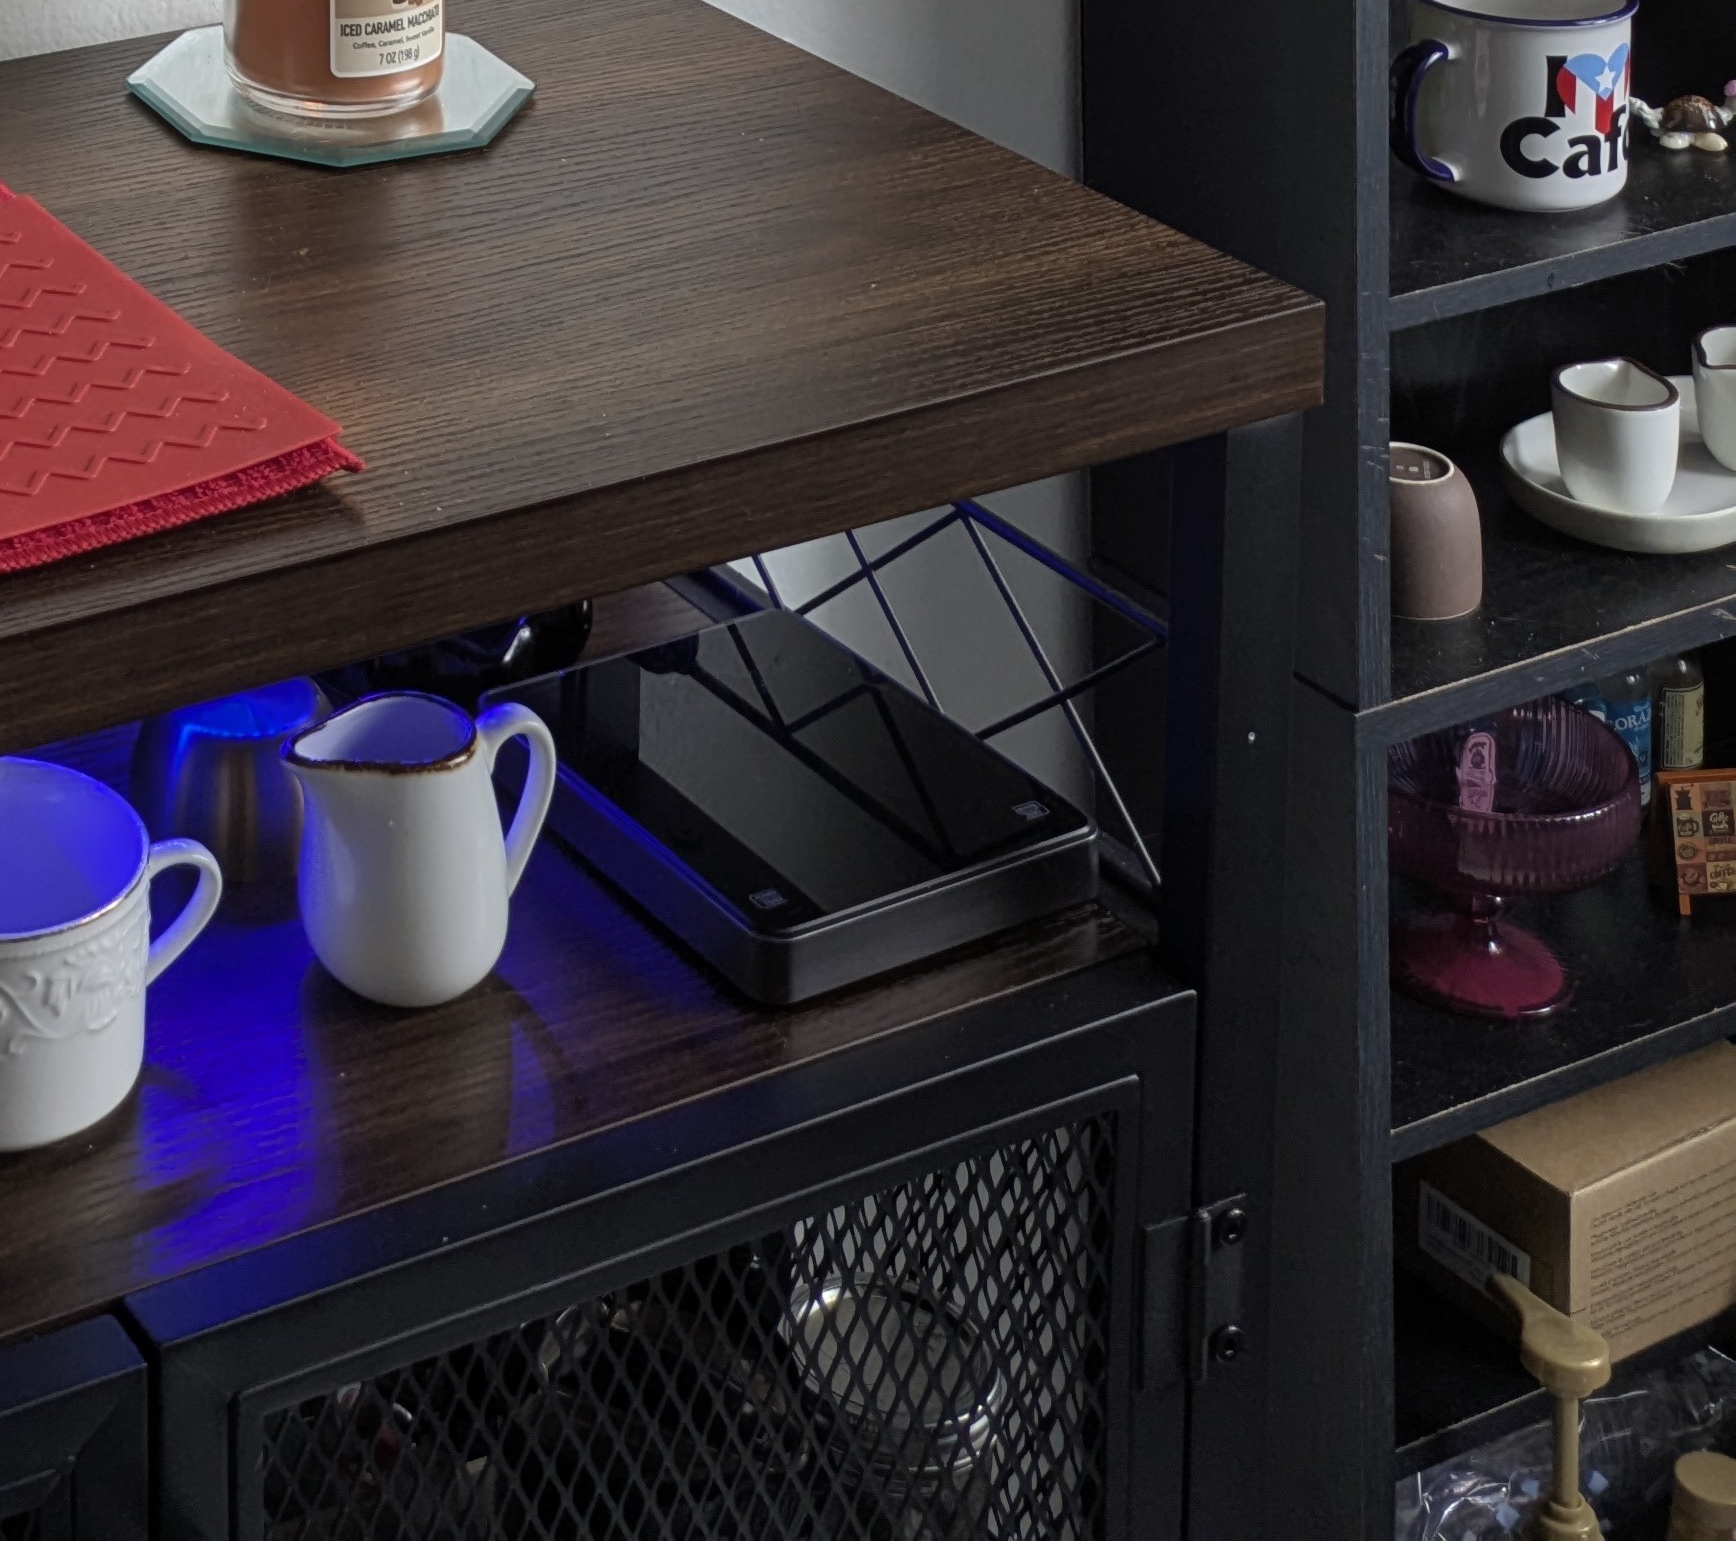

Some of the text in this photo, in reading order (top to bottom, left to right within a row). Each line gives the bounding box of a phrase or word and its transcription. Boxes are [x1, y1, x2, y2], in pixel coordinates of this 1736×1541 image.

[340, 23, 362, 37] ICED
[365, 19, 406, 36] CARAMEL
[386, 51, 396, 64] OZ
